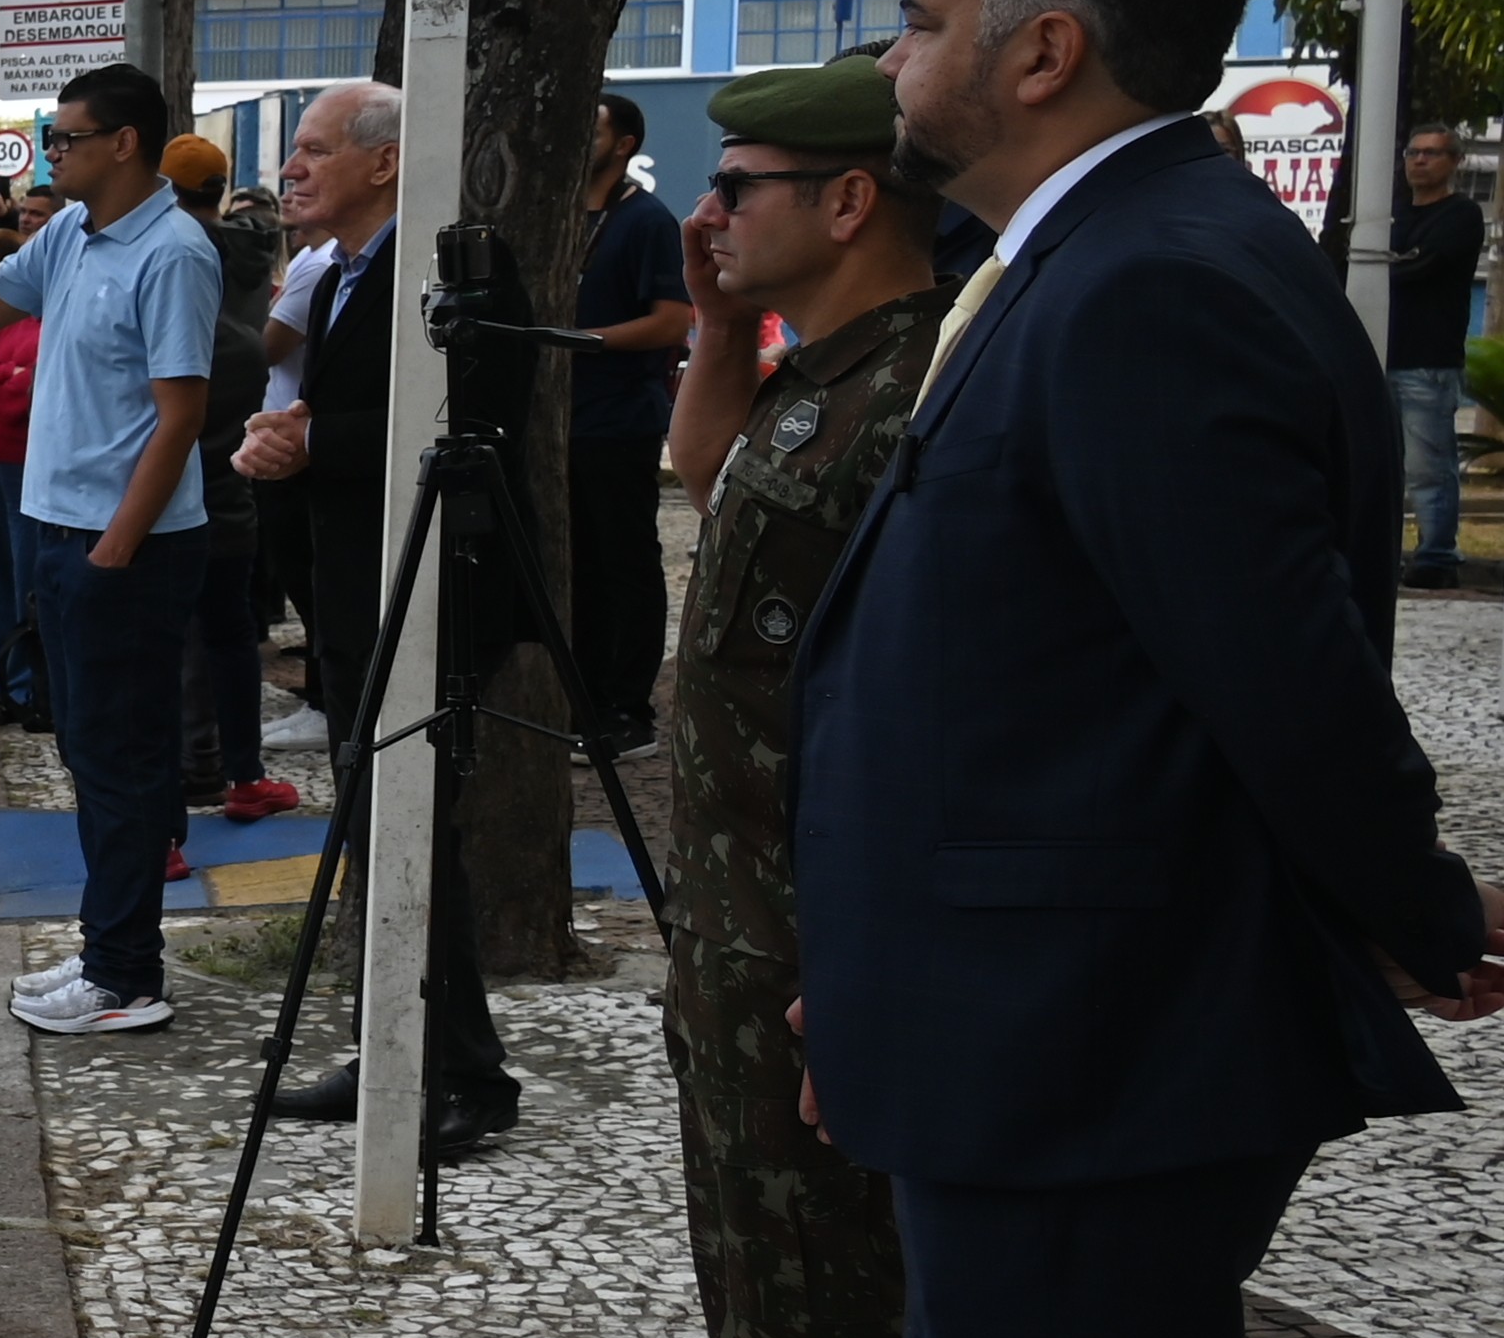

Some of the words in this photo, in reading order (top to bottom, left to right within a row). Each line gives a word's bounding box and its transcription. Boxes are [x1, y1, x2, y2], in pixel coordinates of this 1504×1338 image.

[13, 7, 107, 25] EMBARQUE
[112, 5, 121, 19] E
[4, 22, 126, 43] DESEMBARQU
[0, 56, 36, 68] PISCA
[40, 53, 86, 66] ALERTA
[89, 51, 126, 64] LIGAD
[4, 67, 54, 80] MÁXIMO
[59, 68, 71, 78] 15
[10, 82, 28, 93] NA
